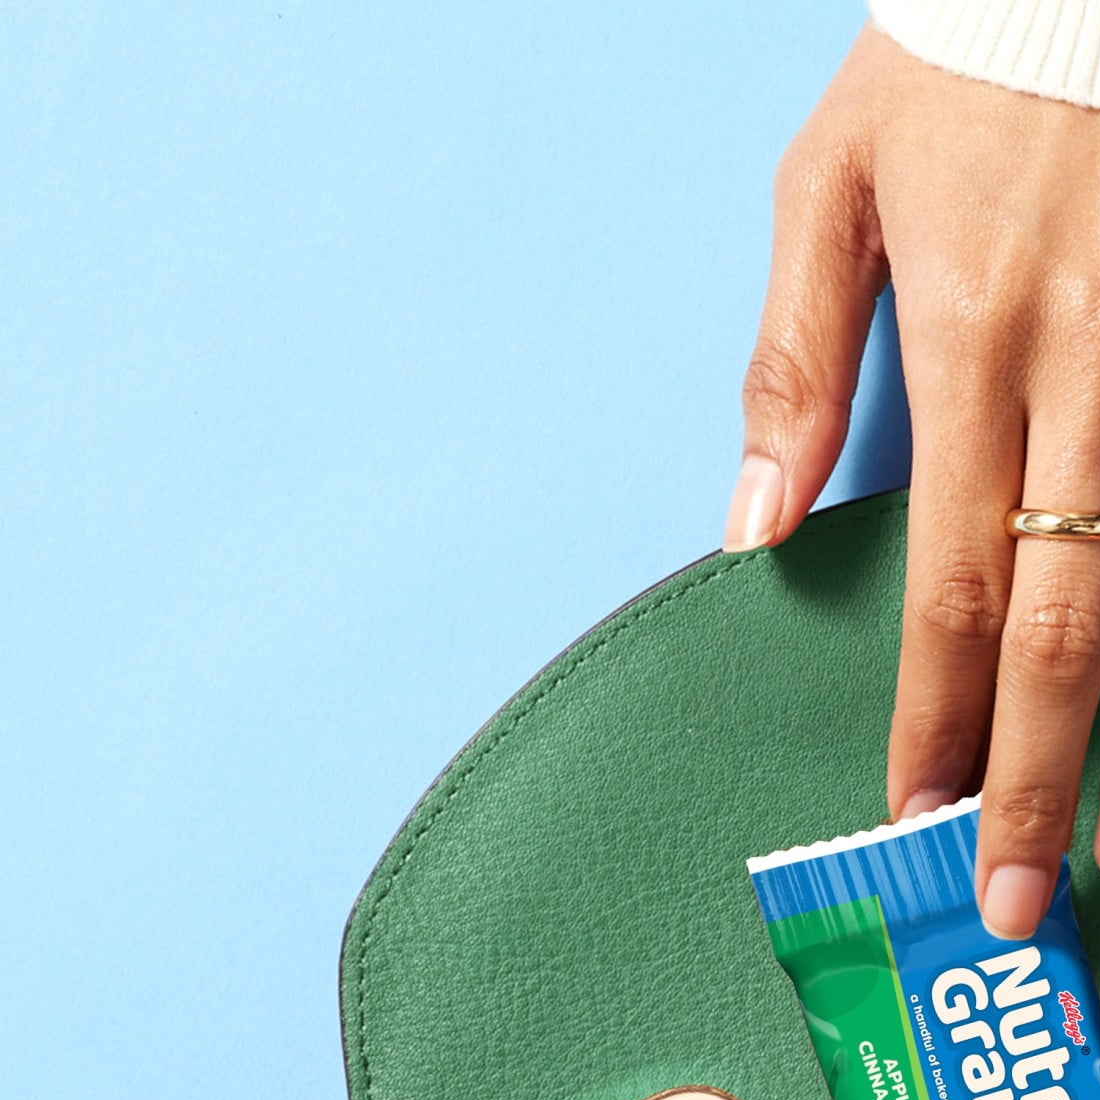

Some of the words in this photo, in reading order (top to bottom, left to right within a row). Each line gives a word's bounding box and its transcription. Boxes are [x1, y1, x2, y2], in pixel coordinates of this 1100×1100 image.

[910, 994, 919, 1003] a
[913, 1005, 935, 1052] handful
[1058, 989, 1086, 1045] Kellogg's
[928, 1054, 940, 1067] of
